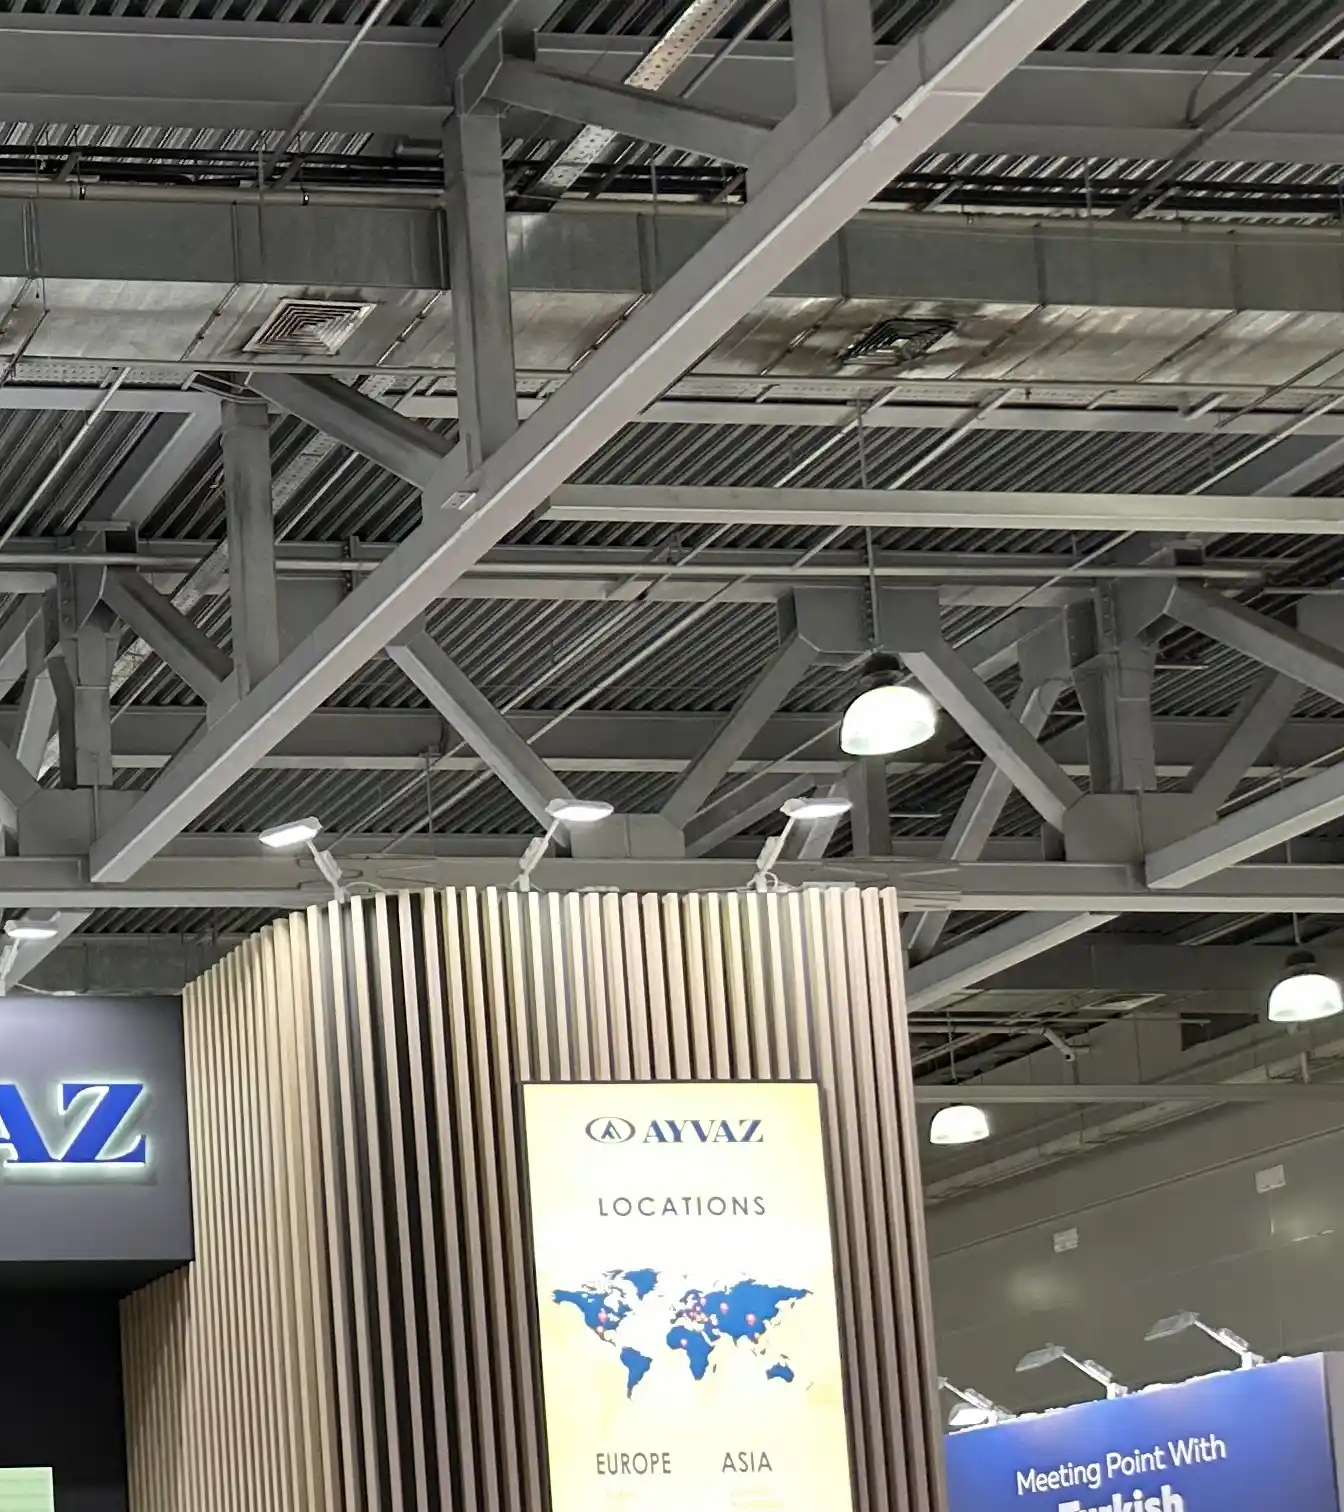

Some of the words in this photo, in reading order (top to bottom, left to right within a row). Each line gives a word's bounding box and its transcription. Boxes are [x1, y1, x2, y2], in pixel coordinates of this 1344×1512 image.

[642, 1119, 764, 1143] AYVAZ
[598, 1196, 766, 1217] LOCATIONS
[596, 1452, 672, 1475] EUROPE
[722, 1451, 773, 1473] ASIA
[1016, 1461, 1102, 1496] Meeting
[1106, 1445, 1167, 1479] Point
[1168, 1433, 1227, 1467] With
